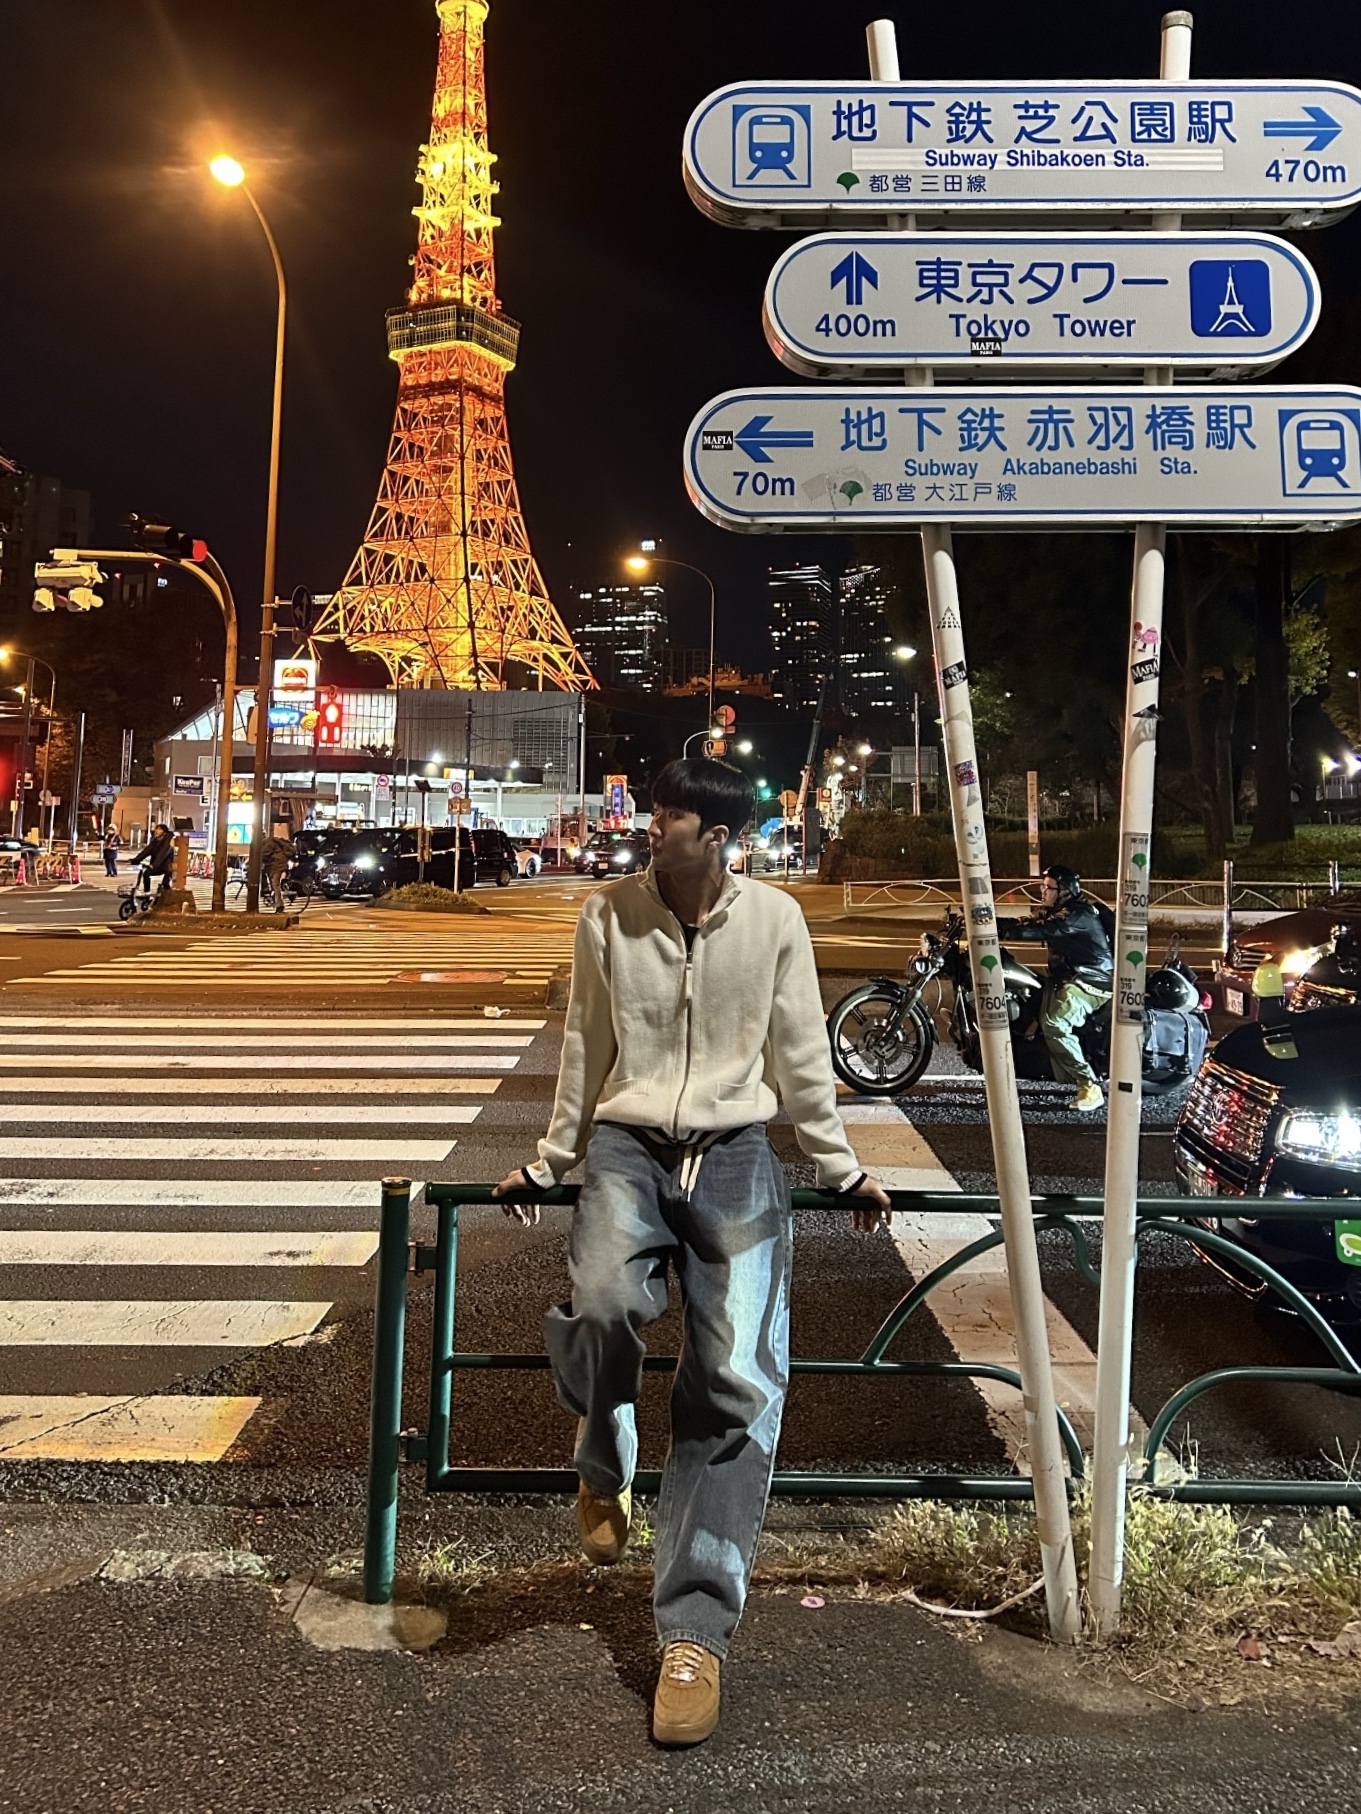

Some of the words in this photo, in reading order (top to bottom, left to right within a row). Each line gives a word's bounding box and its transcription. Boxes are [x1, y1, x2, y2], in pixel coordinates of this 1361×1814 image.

[832, 98, 994, 144] 地下鉄
[1012, 99, 1237, 145] 芝公園駅
[924, 149, 998, 170] Subway
[1006, 149, 1106, 167] Shibakoen
[1113, 149, 1149, 167] Sta.
[1265, 159, 1347, 183] 470m
[869, 174, 912, 193] 都営
[920, 174, 987, 193] 三田線
[915, 257, 1169, 306] 東京タワー
[815, 313, 896, 338] 400m
[948, 313, 1031, 342] Tokyo
[1054, 313, 1136, 338] Tower
[971, 341, 1001, 351] MAFIA
[703, 435, 733, 445] MAFIA
[840, 405, 1008, 453] 地下鉄
[1026, 404, 1257, 453] 赤羽橋駅
[904, 457, 979, 479] Subway
[1002, 457, 1137, 476] Akabanebashi
[1159, 457, 1198, 476] Sta.
[733, 471, 795, 496] 70m
[871, 482, 917, 502] 都営
[924, 482, 1018, 502] 大江戸線
[1124, 893, 1149, 907] 760
